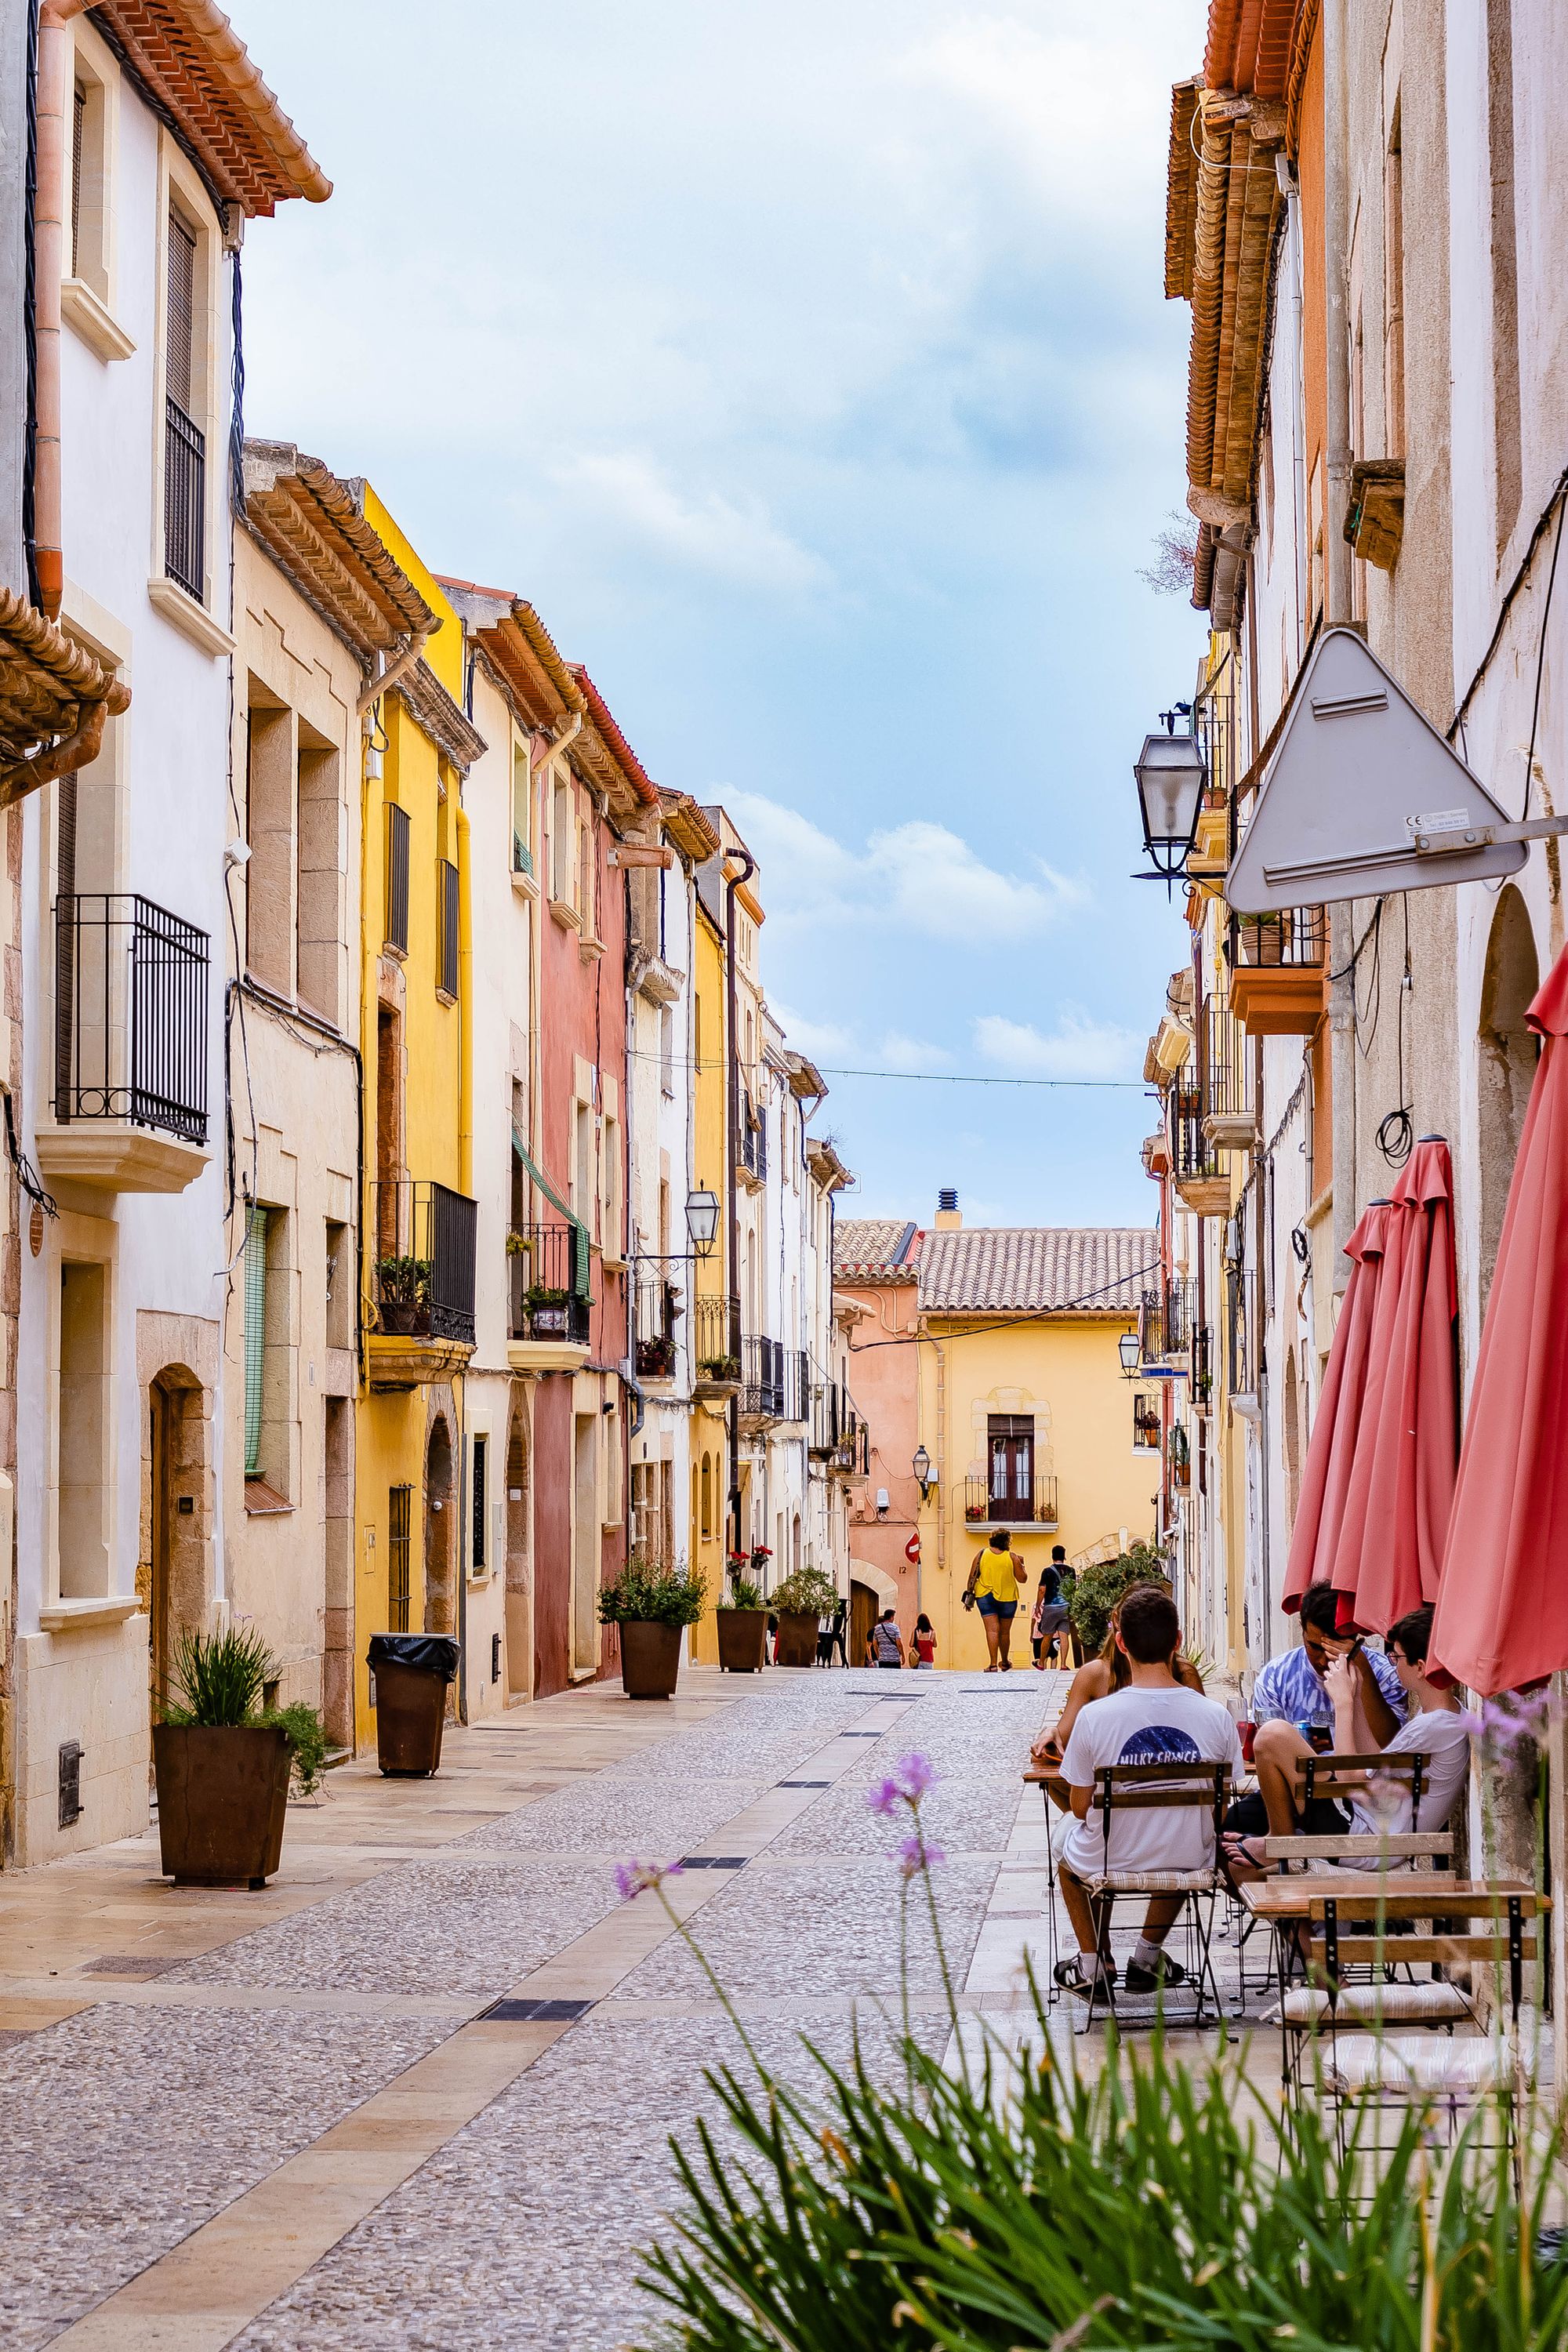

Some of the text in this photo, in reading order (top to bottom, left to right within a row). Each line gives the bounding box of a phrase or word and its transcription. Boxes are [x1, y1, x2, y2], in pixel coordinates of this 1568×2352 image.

[1406, 815, 1422, 827] CE
[1120, 1751, 1198, 1766] MILKY CHANCE
[1065, 1968, 1077, 1986] N
